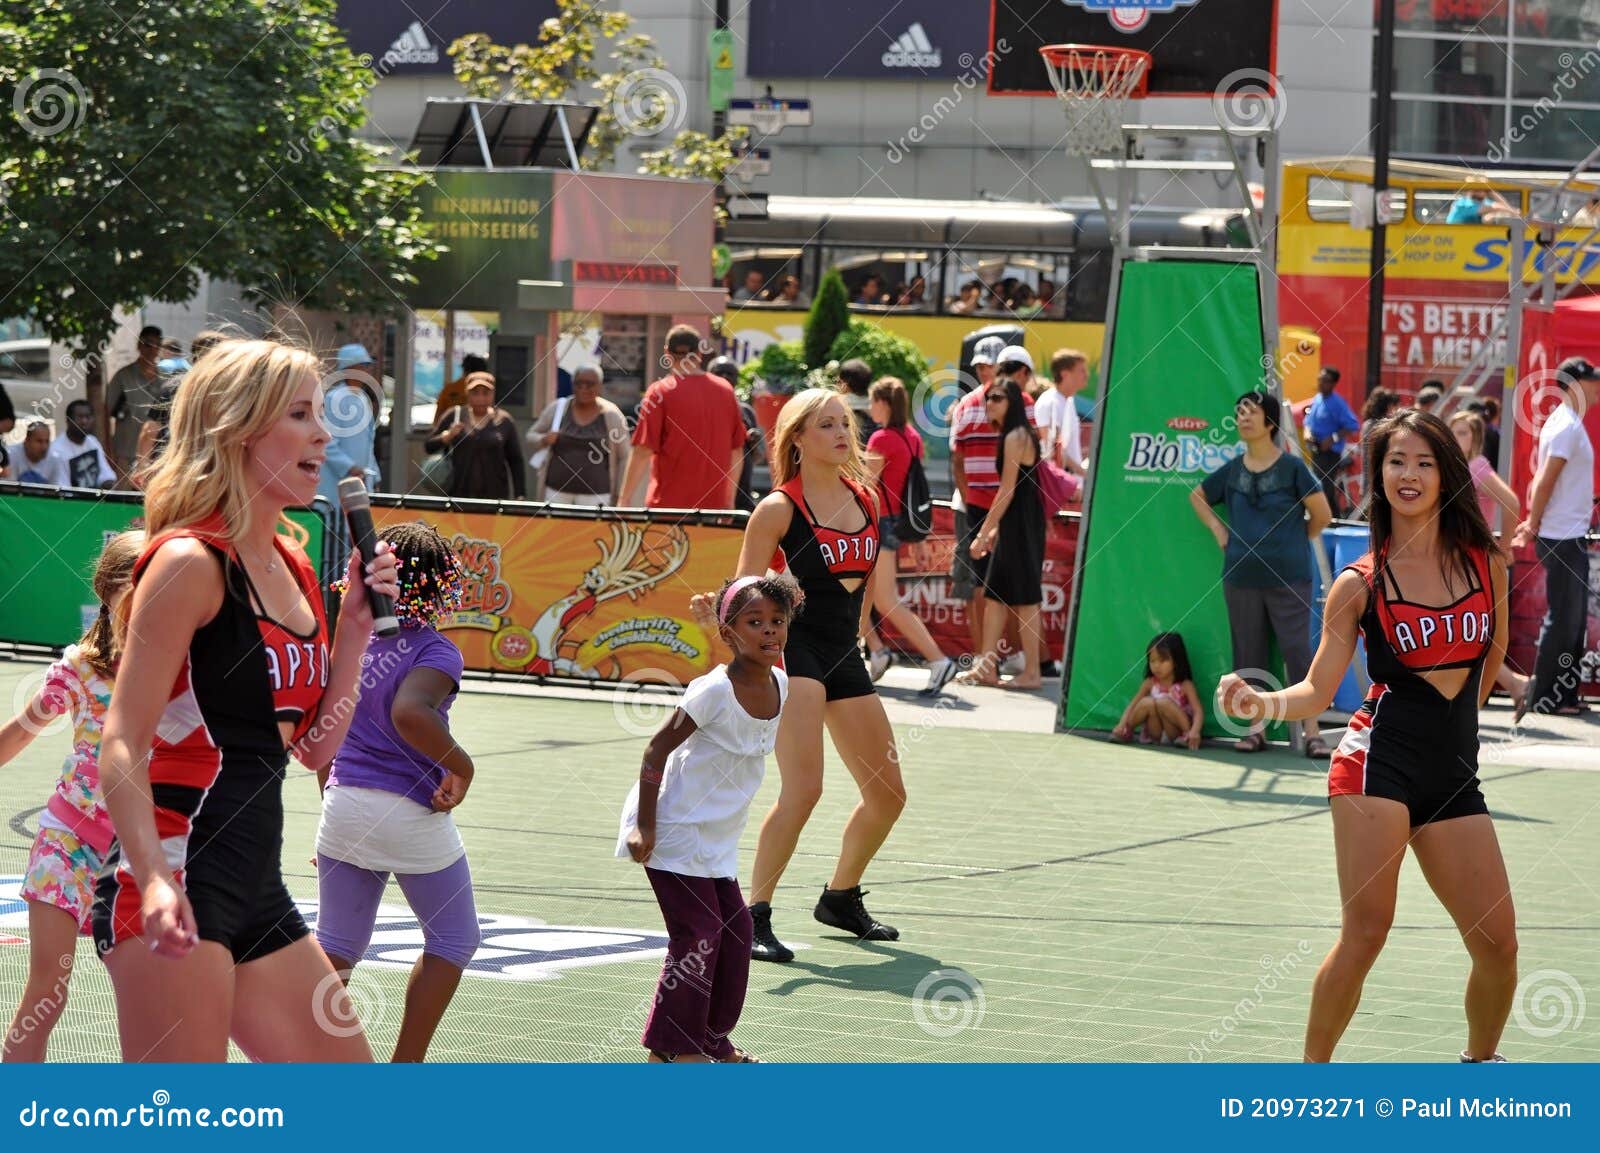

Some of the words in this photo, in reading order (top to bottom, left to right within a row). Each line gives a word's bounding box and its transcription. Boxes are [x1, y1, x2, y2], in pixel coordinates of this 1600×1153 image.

[881, 46, 942, 68] adidas
[433, 198, 541, 215] INFORMATION
[1403, 234, 1431, 246] HOP
[1433, 235, 1454, 247] ON
[1403, 250, 1431, 262] HOP
[1432, 252, 1457, 263] OFF
[1406, 336, 1425, 366] A
[819, 536, 878, 567] APTO
